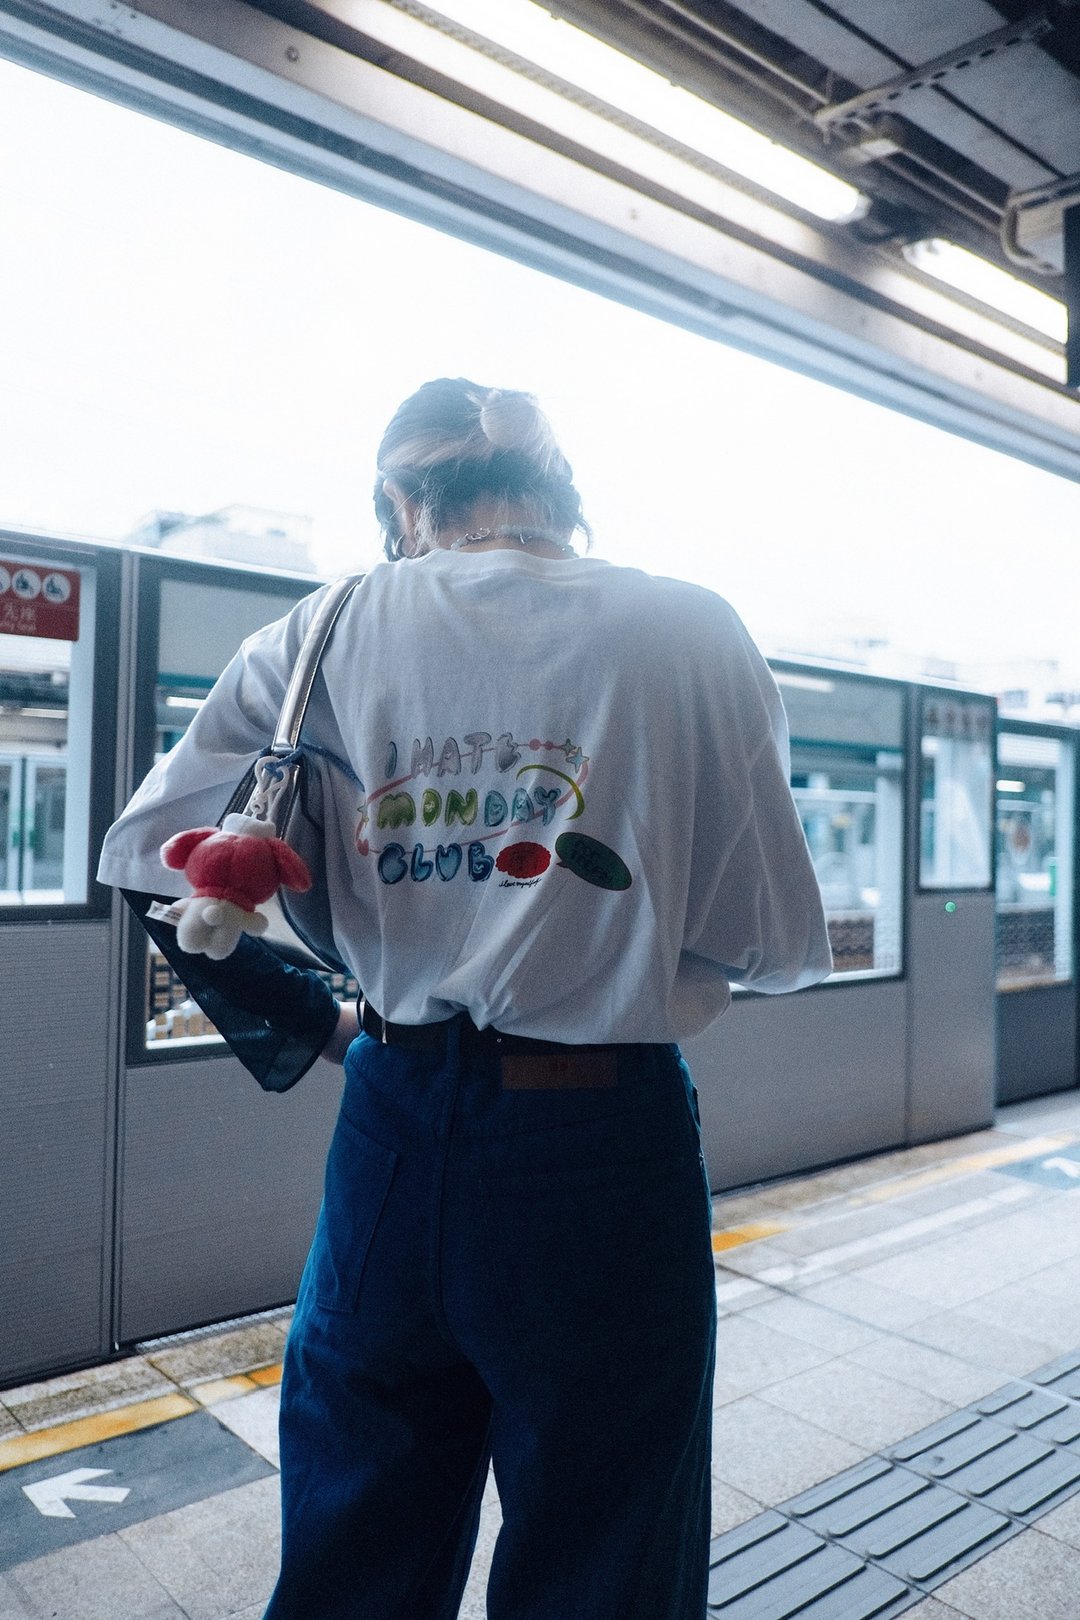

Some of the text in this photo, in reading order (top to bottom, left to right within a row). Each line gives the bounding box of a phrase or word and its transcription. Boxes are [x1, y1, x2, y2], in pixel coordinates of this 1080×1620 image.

[384, 731, 521, 779] I HATE
[376, 788, 561, 829] MONDAY
[378, 841, 495, 884] CLUB
